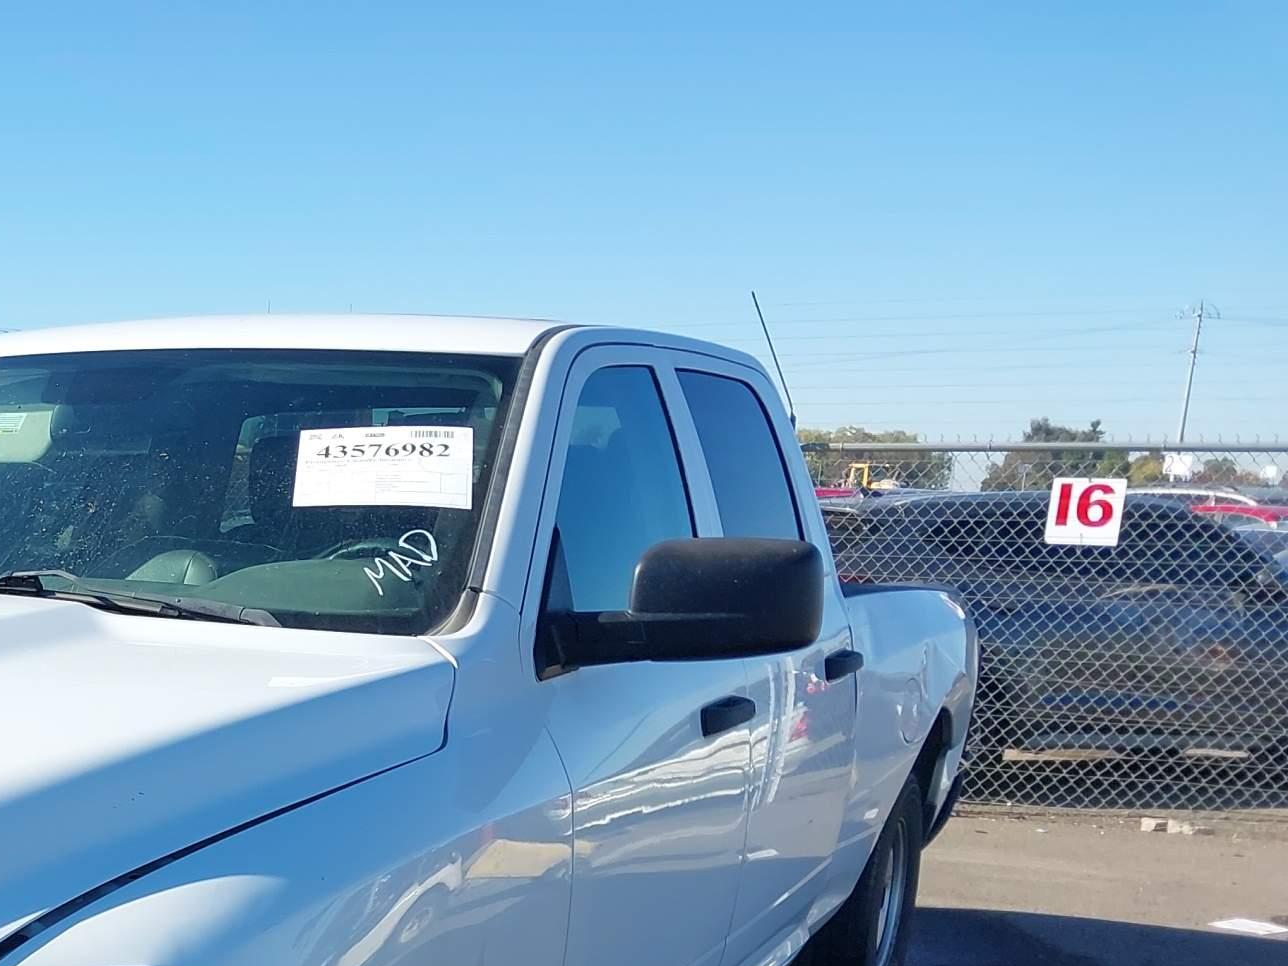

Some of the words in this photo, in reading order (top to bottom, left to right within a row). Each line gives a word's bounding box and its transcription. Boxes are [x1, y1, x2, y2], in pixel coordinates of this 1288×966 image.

[316, 442, 450, 459] 43576982
[1055, 483, 1116, 528] 16
[363, 529, 438, 596] MAD
